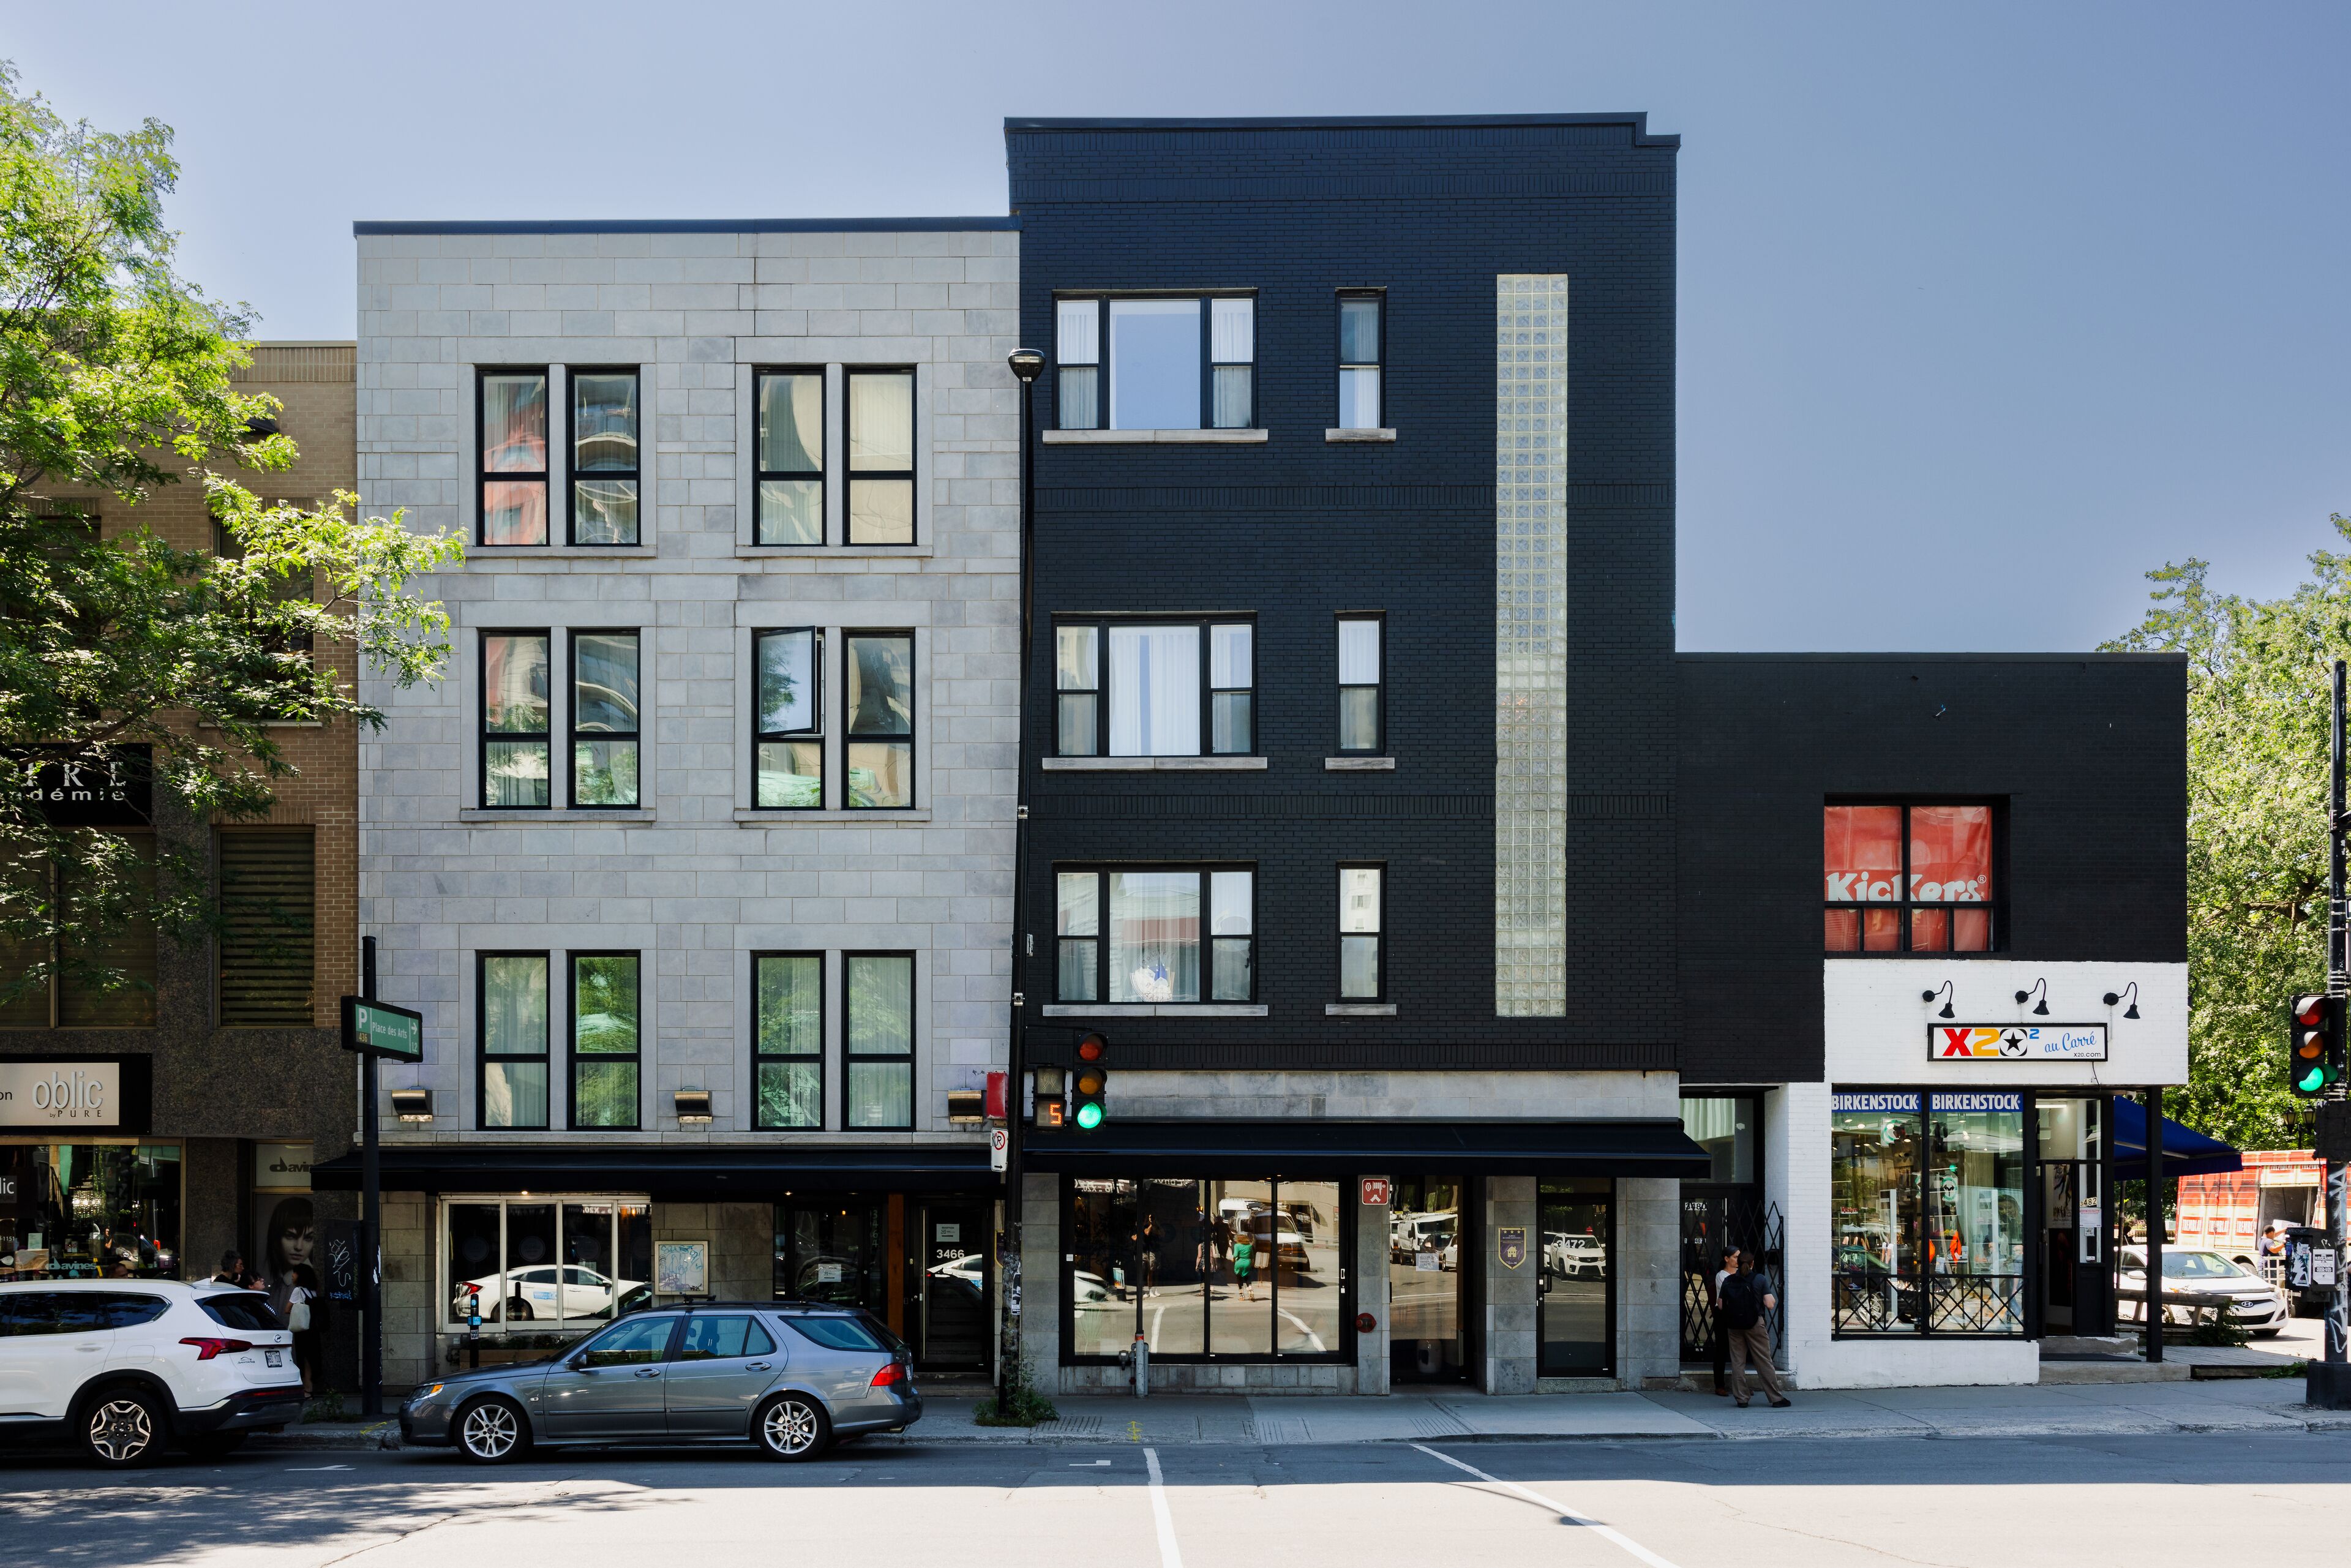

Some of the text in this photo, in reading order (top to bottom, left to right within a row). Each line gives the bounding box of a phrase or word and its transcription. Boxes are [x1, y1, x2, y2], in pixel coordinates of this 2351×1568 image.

[359, 1008, 367, 1029] P
[372, 1022, 386, 1033] Place
[398, 1029, 407, 1038] Arts
[2044, 1031, 2097, 1053] au Carré
[32, 1071, 103, 1109] oblic
[1831, 1095, 1918, 1110] BIRKENSTOCK
[1932, 1095, 2020, 1110] BIRKENSTOCK
[1050, 1104, 1061, 1124] 5
[2080, 1198, 2097, 1207] 3482
[1556, 1240, 1585, 1249] 3472
[936, 1249, 965, 1259] 3466
[45, 1258, 97, 1270] davines
